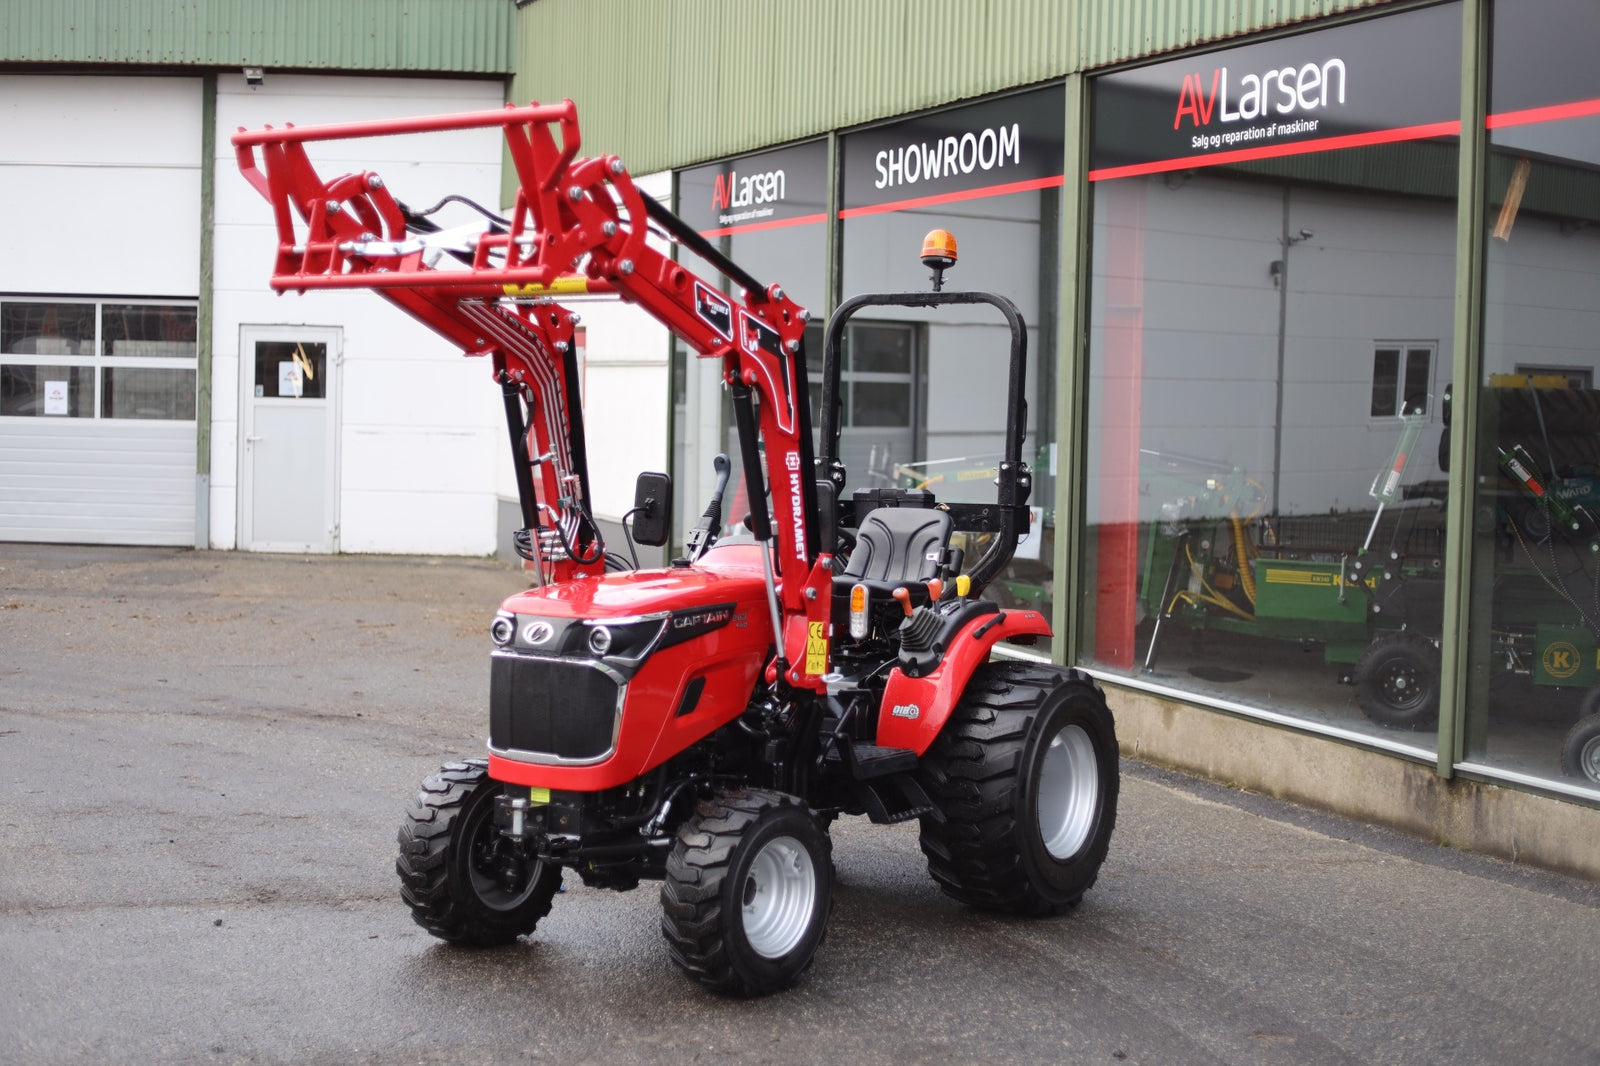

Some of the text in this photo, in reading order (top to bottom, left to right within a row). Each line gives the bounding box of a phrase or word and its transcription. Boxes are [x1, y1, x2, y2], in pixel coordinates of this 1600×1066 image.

[1191, 119, 1319, 149] Salg og reparation af maskiner
[875, 123, 1020, 189] SHOWROOM
[789, 473, 806, 561] HYDRAMET
[673, 609, 729, 629] CAPTAIN
[1553, 651, 1570, 668] K
